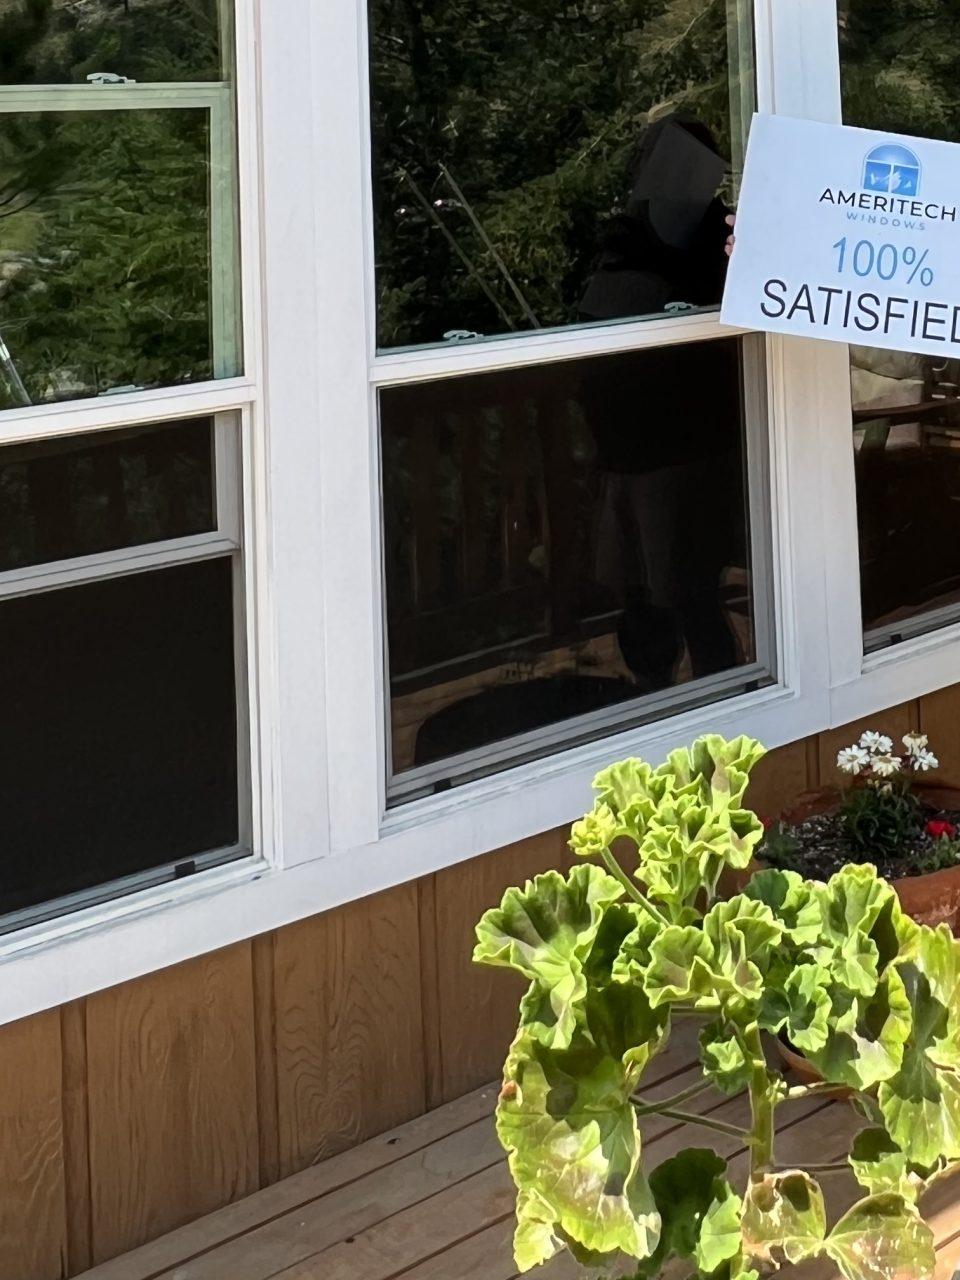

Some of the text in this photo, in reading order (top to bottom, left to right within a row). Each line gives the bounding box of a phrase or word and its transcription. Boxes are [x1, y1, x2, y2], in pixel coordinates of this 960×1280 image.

[819, 187, 956, 222] AMERITECH
[846, 212, 926, 231] WINDOWS
[832, 237, 934, 287] 100%
